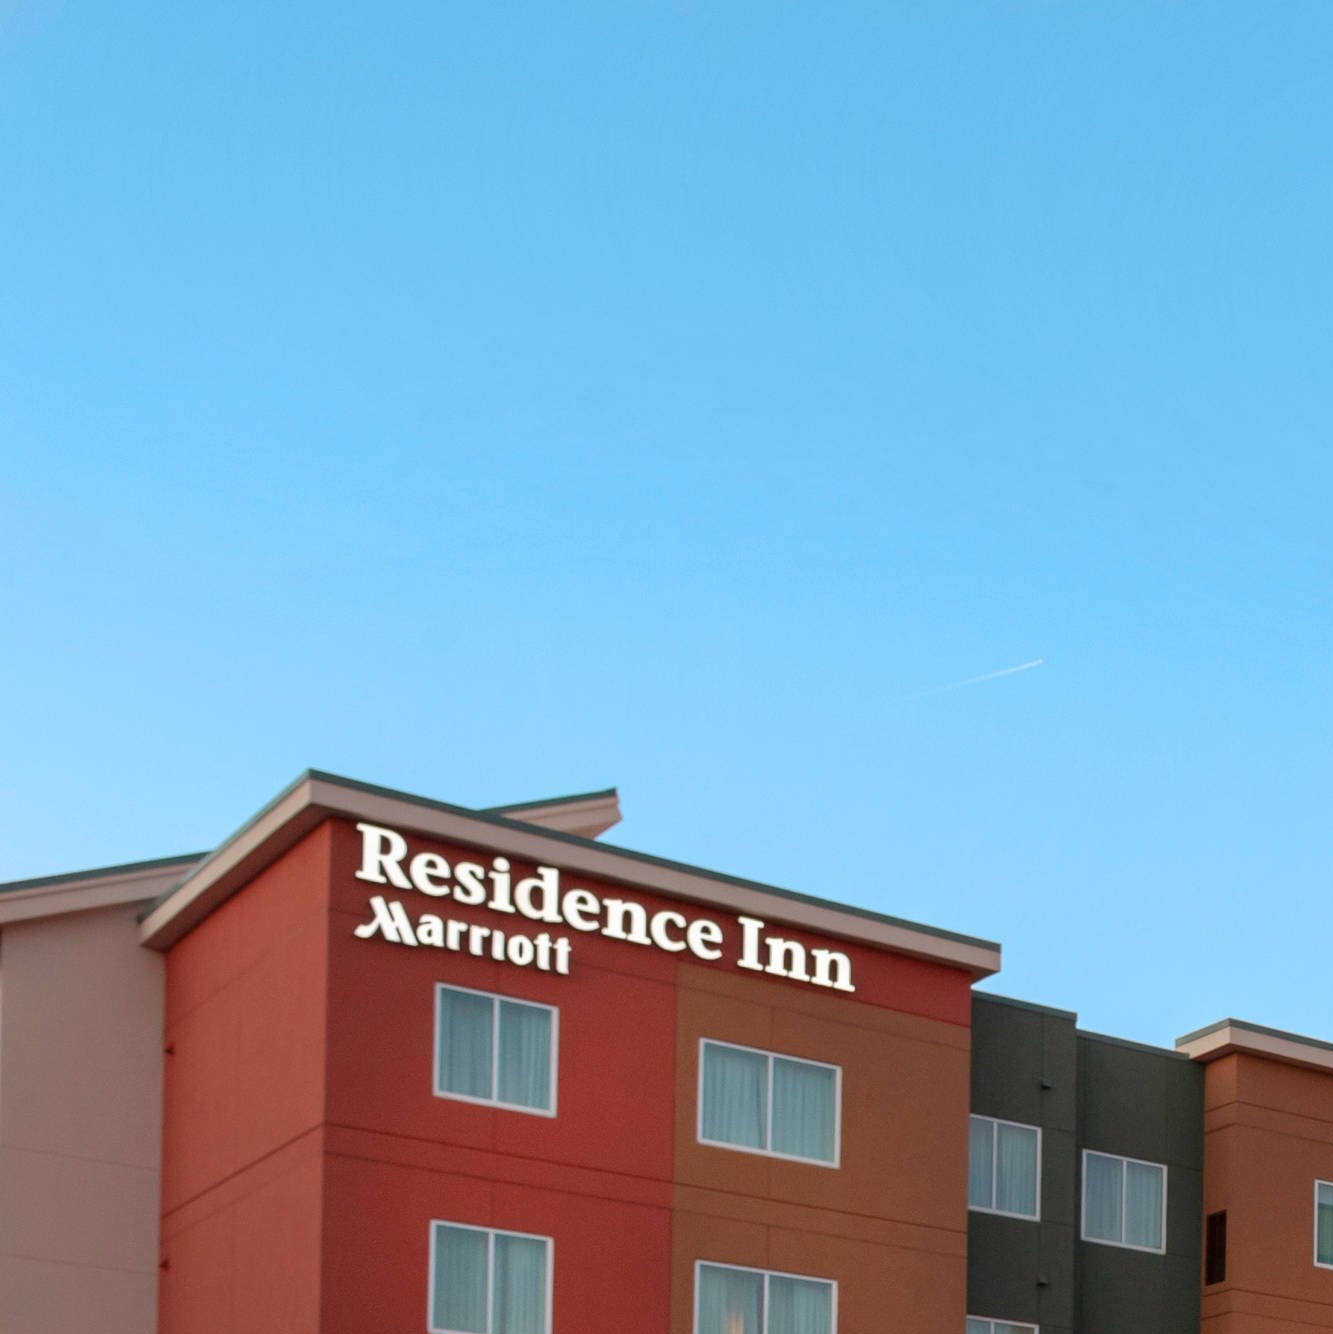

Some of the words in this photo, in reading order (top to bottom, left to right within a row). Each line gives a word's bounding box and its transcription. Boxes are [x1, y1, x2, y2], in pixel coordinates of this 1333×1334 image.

[354, 822, 724, 962] Residence
[737, 915, 856, 992] Inn
[354, 895, 572, 975] Marriott
